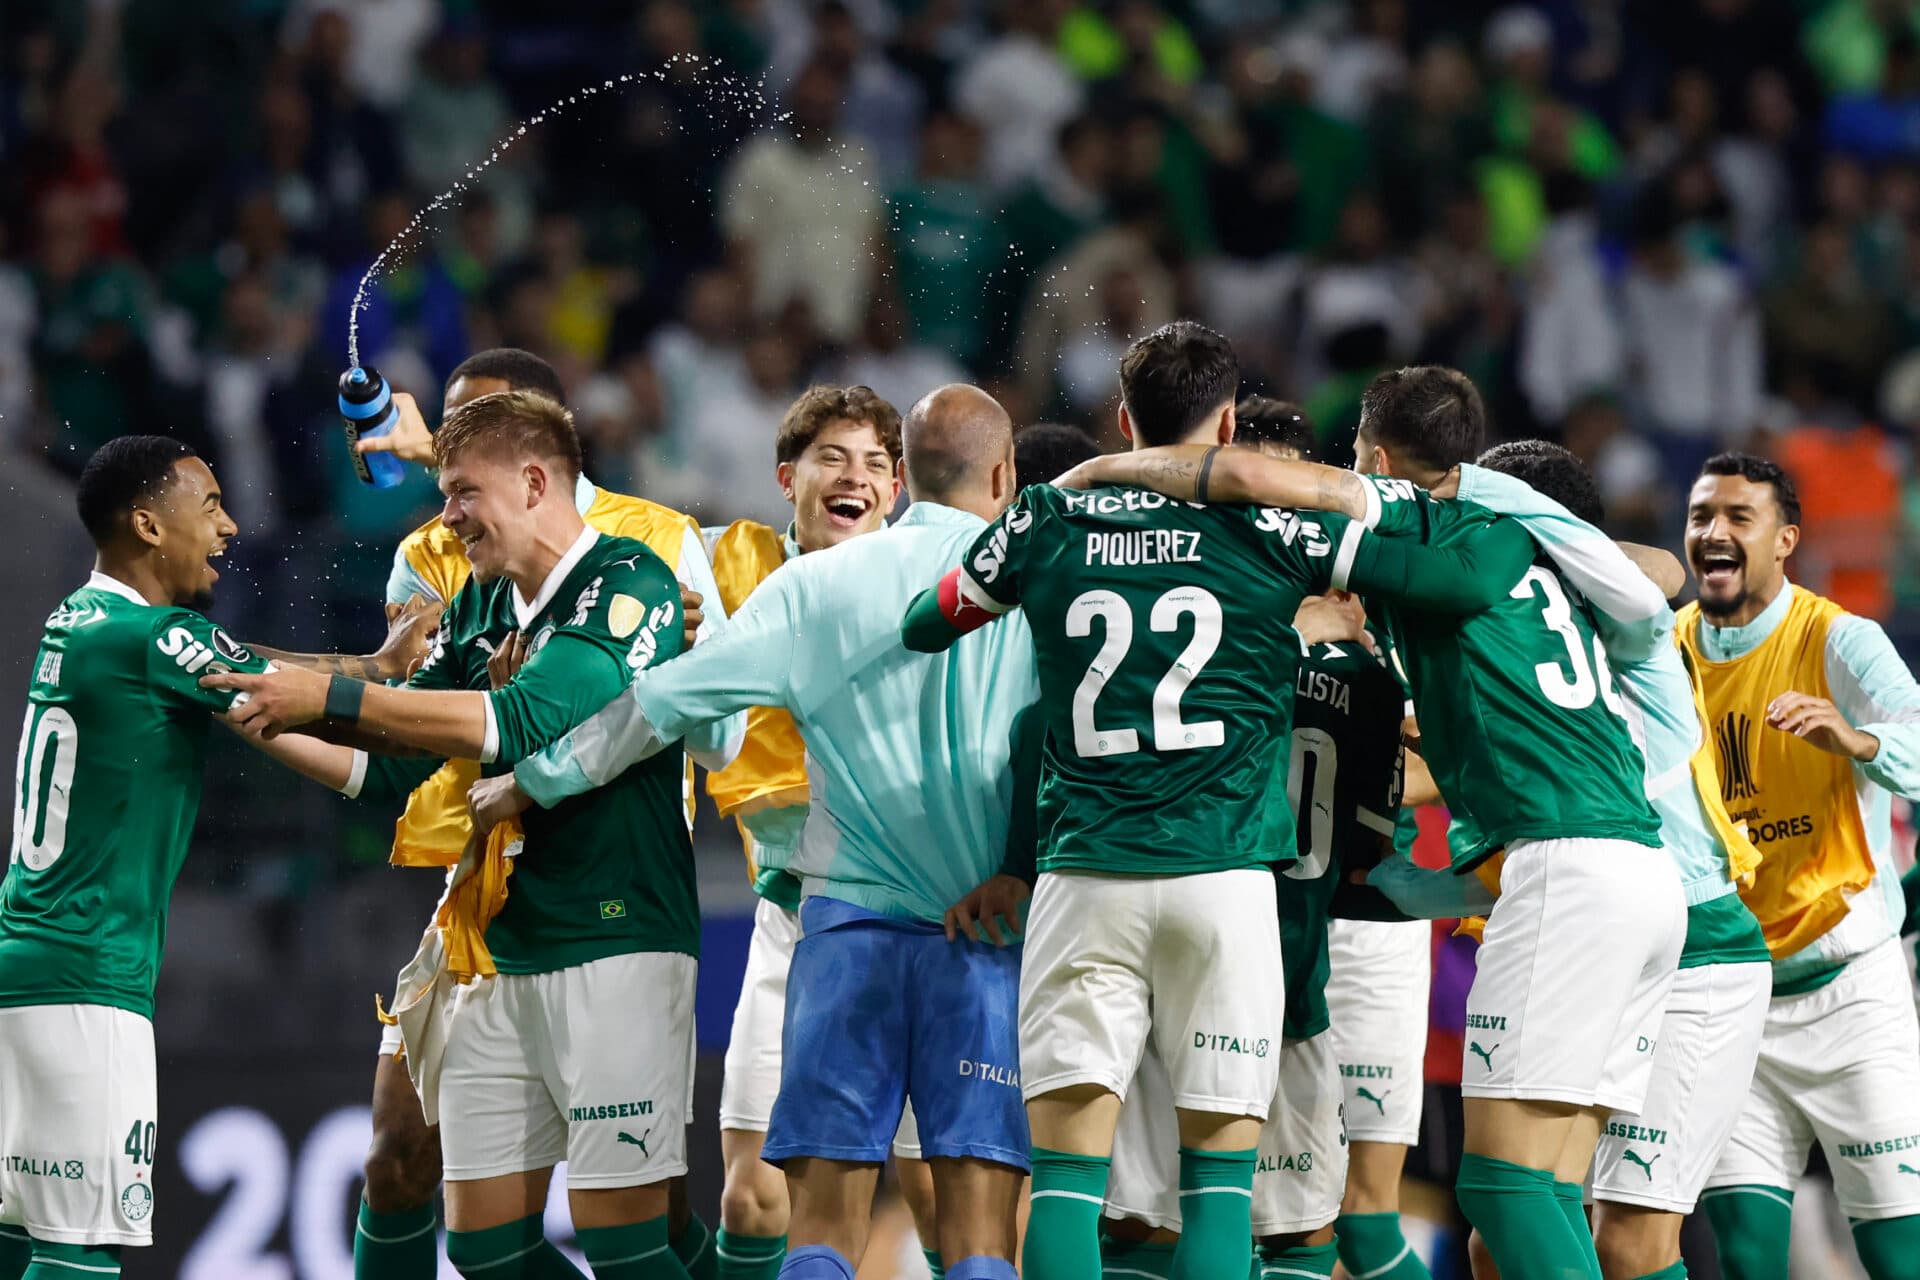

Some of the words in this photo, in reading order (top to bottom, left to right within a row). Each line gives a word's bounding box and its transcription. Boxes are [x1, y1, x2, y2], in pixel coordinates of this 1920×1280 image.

[1085, 529, 1202, 567] PIQUEREZ
[1066, 586, 1225, 758] 22
[125, 1119, 156, 1166] 40
